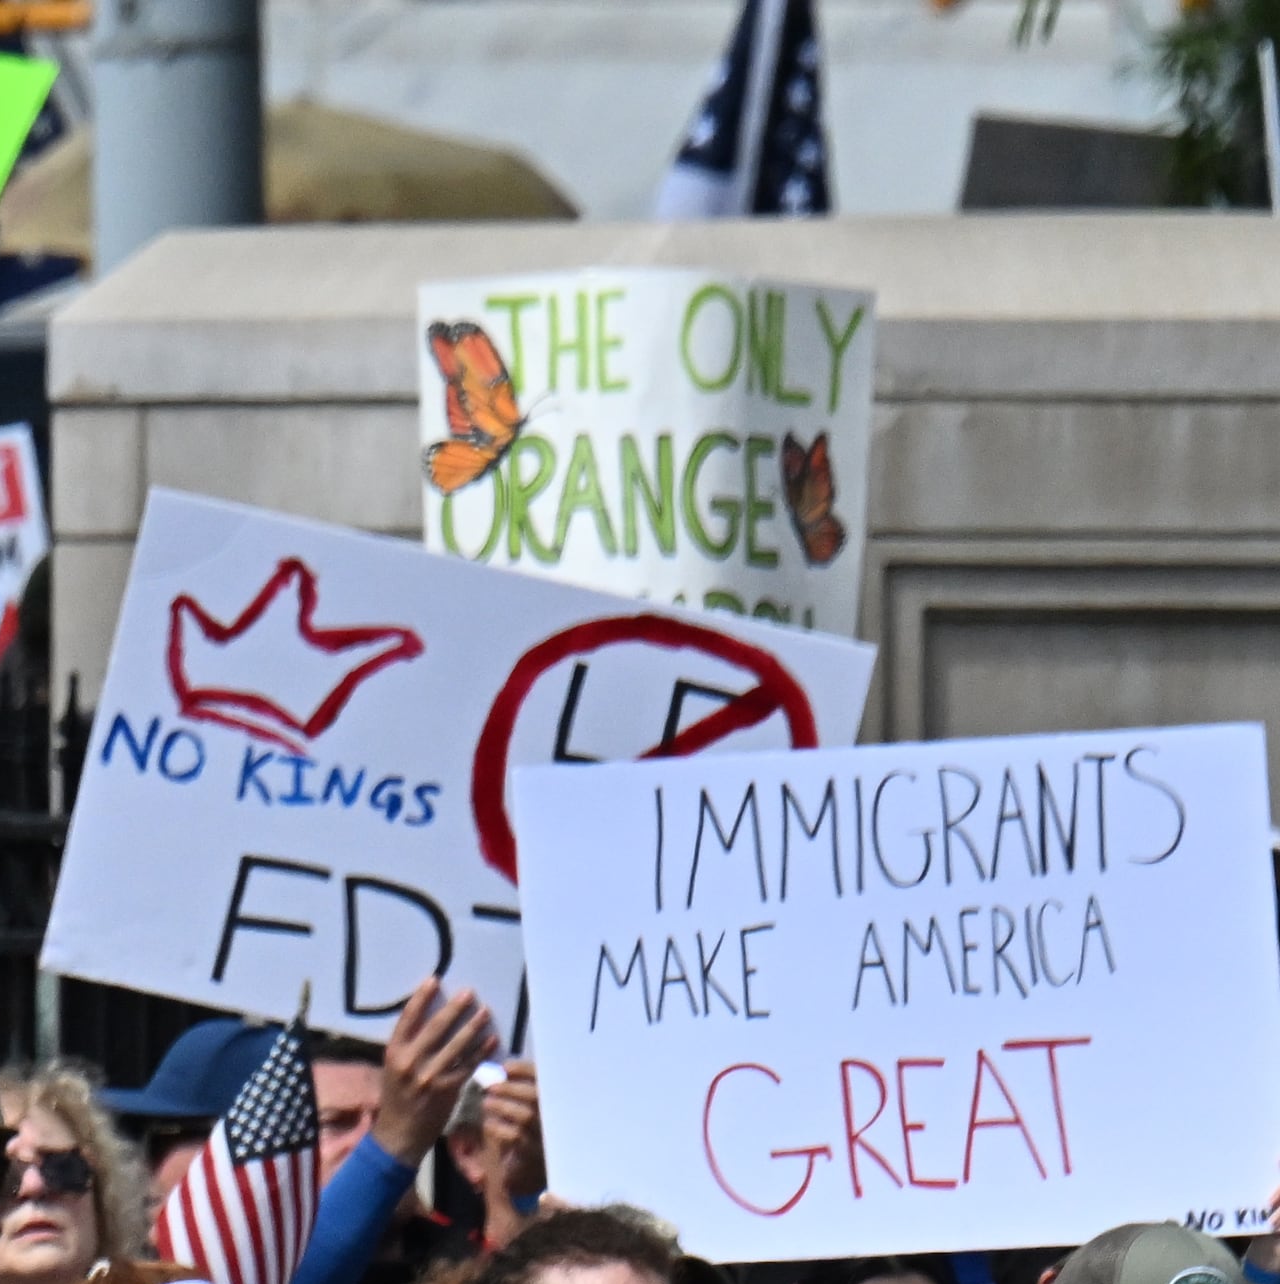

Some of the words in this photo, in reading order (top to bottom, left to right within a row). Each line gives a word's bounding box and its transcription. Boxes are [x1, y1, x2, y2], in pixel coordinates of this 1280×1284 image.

[485, 287, 628, 396] THE
[680, 282, 865, 414] ONLY
[101, 710, 206, 783] NO
[239, 742, 442, 828] KINGS
[654, 746, 1186, 913] IMMIGRANTS
[590, 922, 776, 1034] MAKE
[852, 895, 1117, 1012] AMERICA
[702, 1035, 1092, 1217] GREAT
